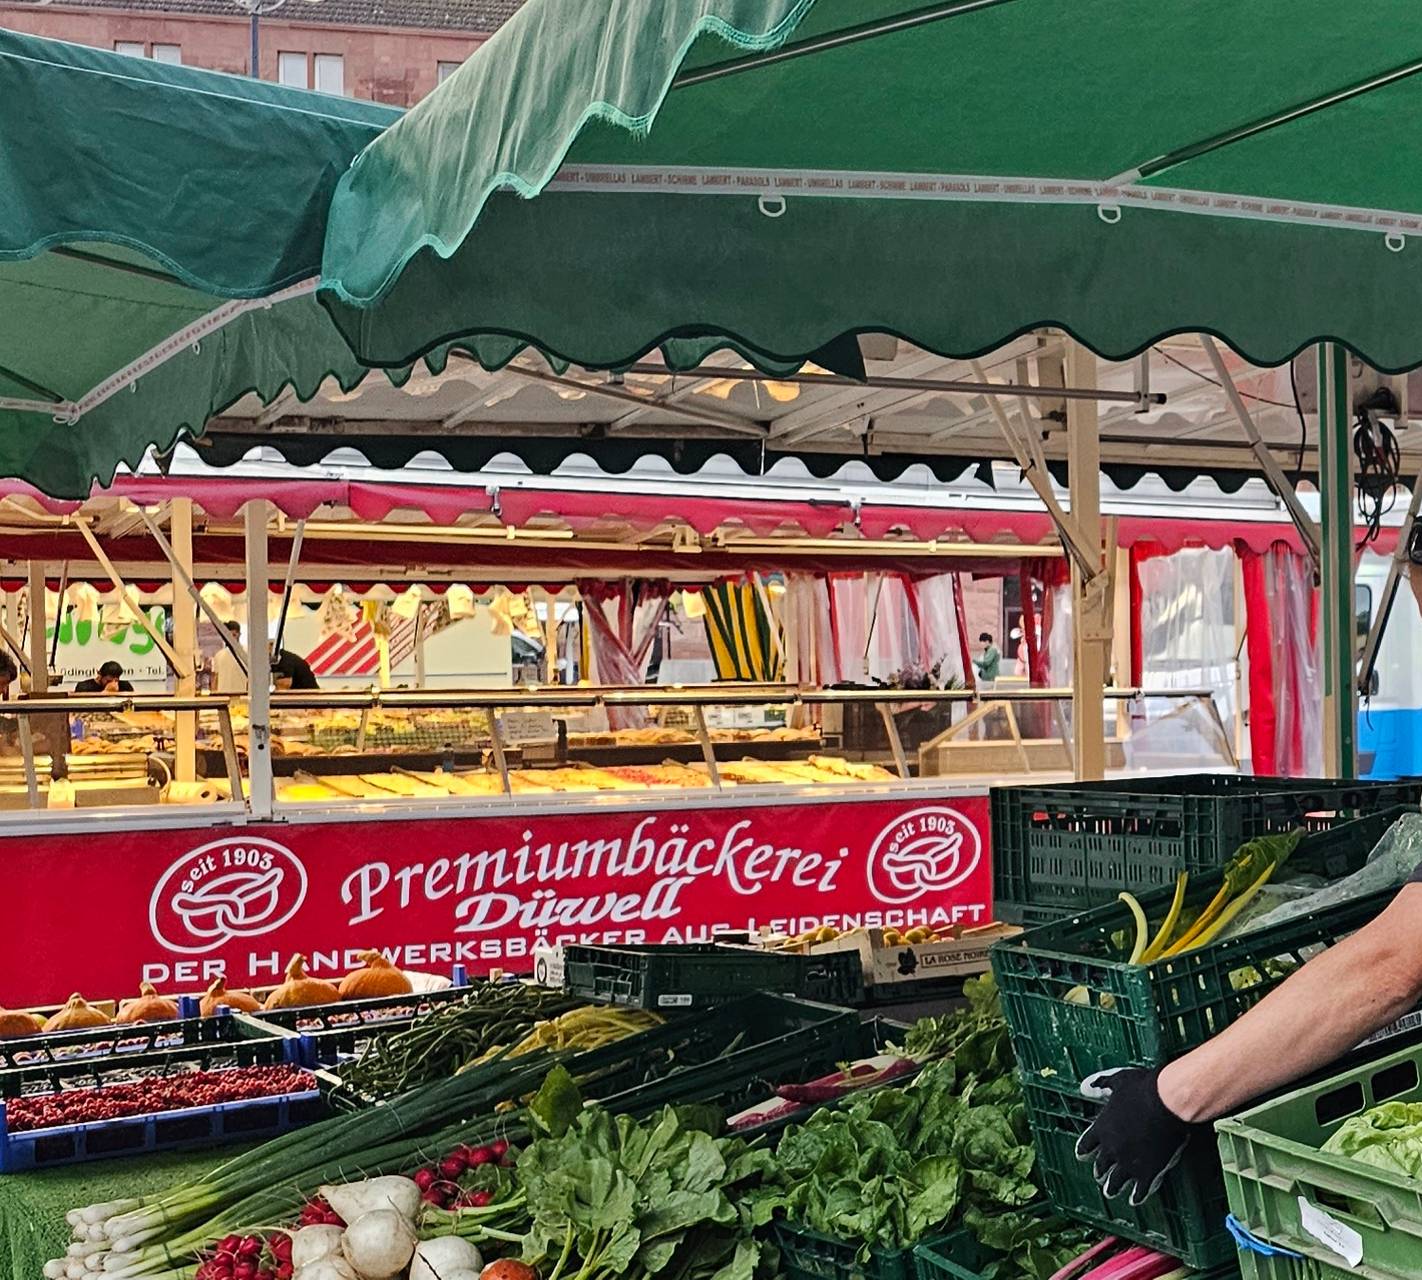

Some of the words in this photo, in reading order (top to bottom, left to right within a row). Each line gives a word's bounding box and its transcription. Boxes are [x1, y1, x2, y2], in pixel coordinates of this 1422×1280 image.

[888, 817, 917, 855] seit
[920, 814, 957, 837] 1903
[181, 852, 217, 895] seit
[222, 848, 275, 872] 1903
[341, 815, 849, 927] Premiumbäckerei
[454, 875, 695, 934] Düwell
[142, 959, 227, 984] DER
